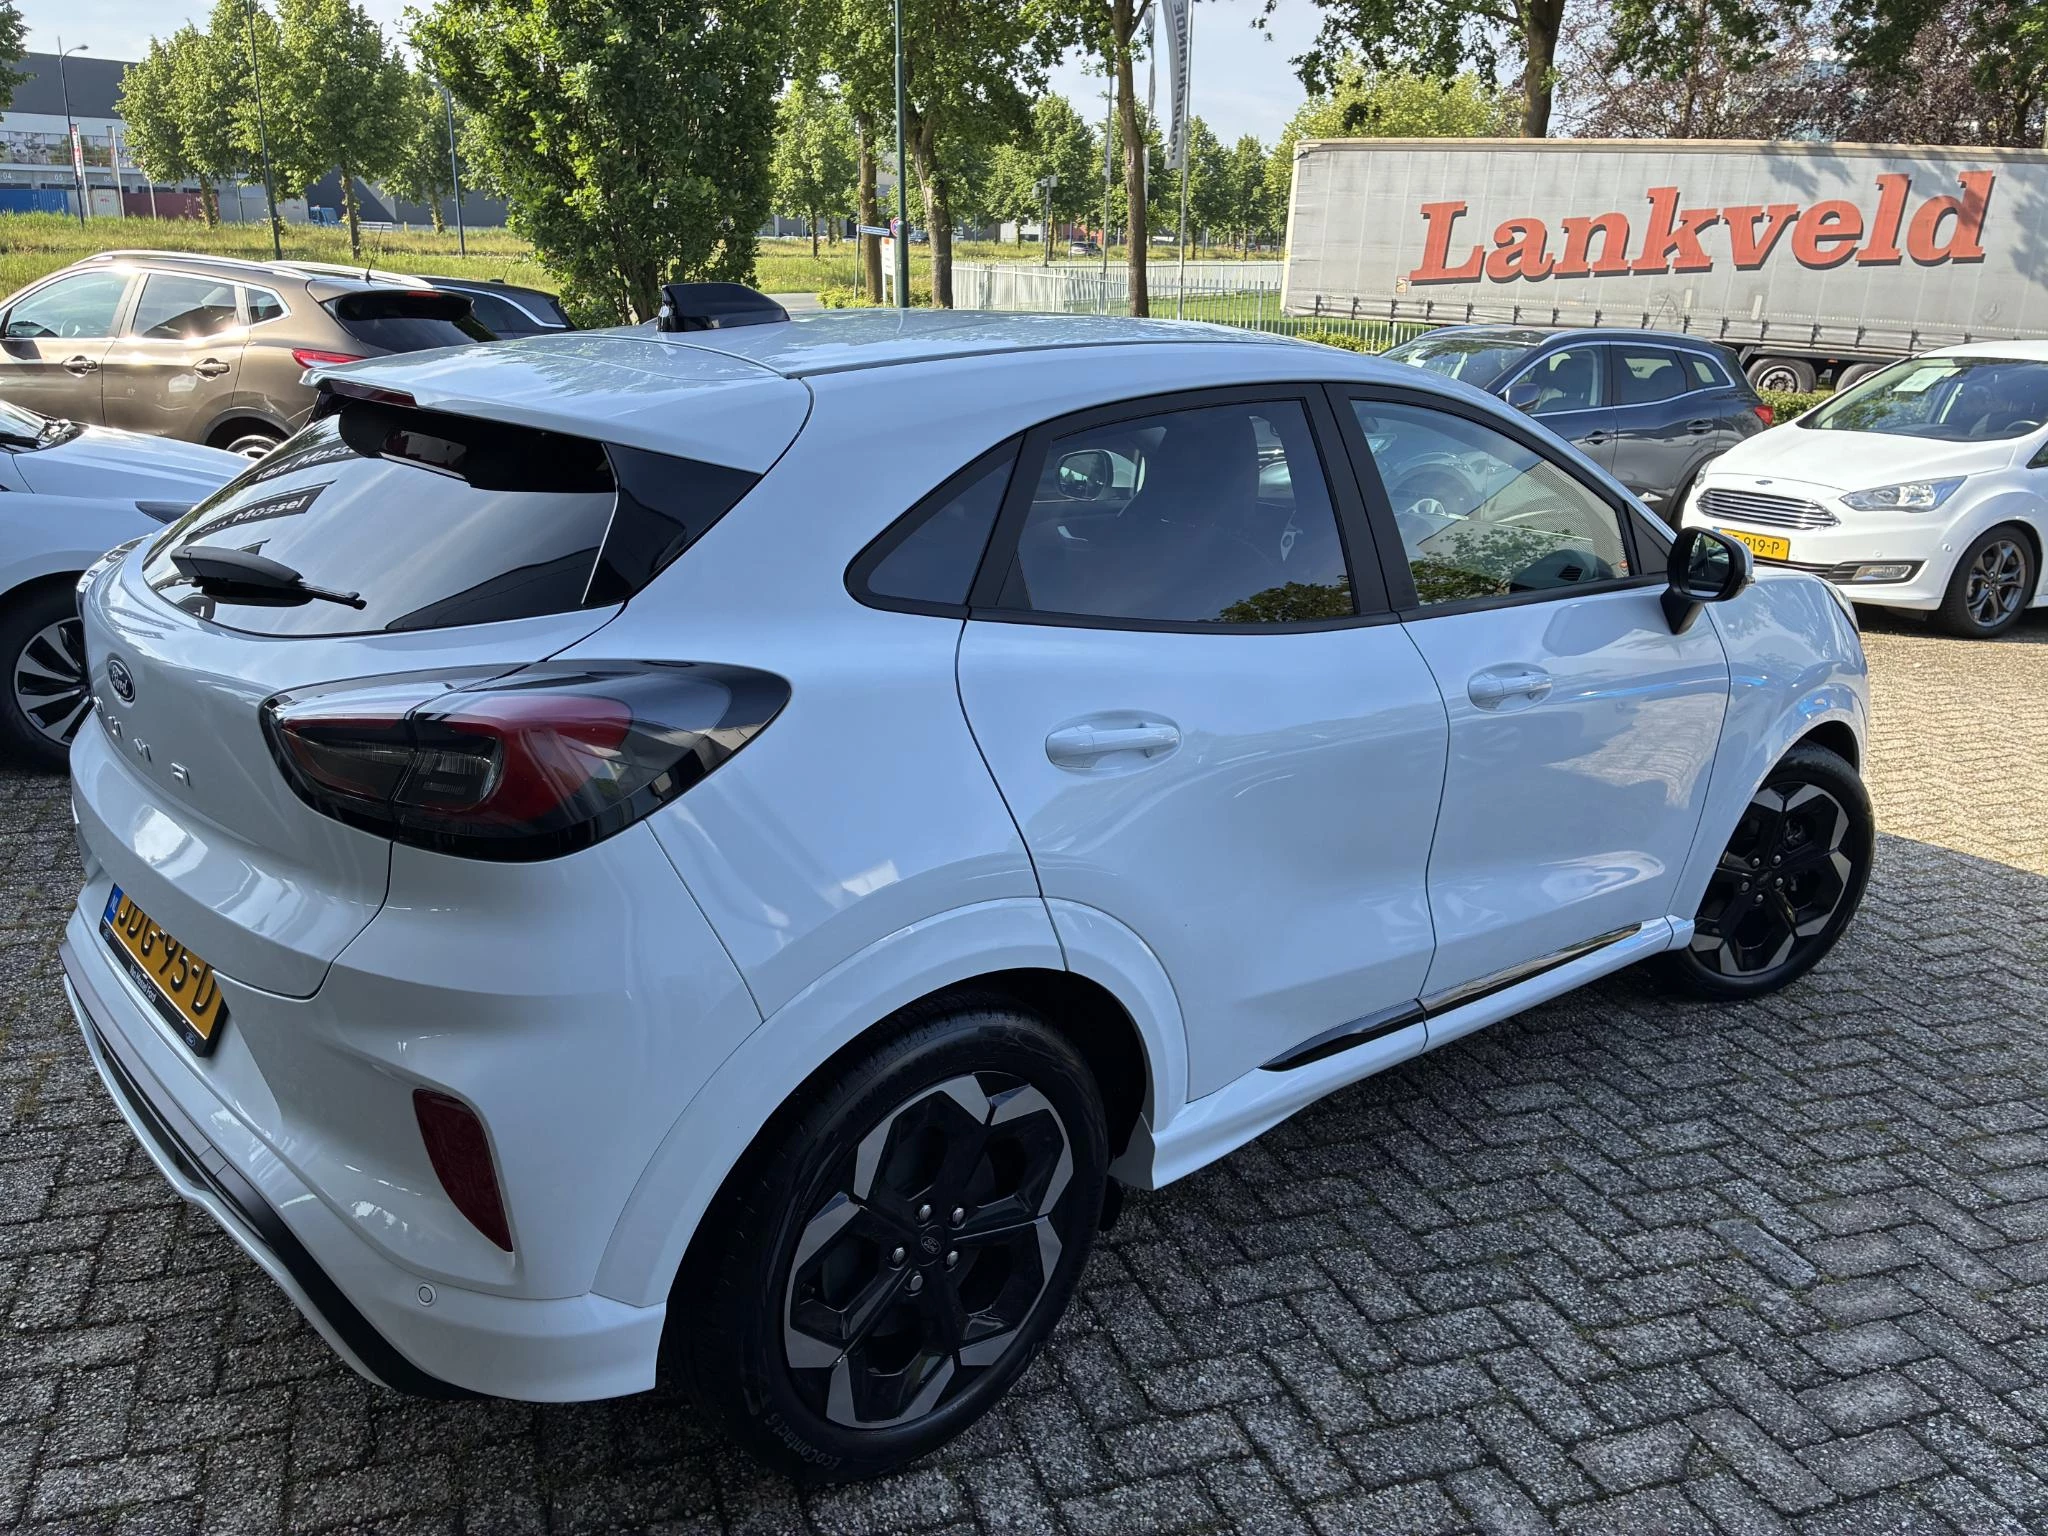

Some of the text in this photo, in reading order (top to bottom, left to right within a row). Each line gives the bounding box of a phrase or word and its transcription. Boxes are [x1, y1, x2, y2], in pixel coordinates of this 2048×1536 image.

[1409, 169, 1995, 286] Lankveld
[292, 446, 354, 469] Moss
[232, 495, 309, 523] Mossel
[110, 894, 119, 913] NL
